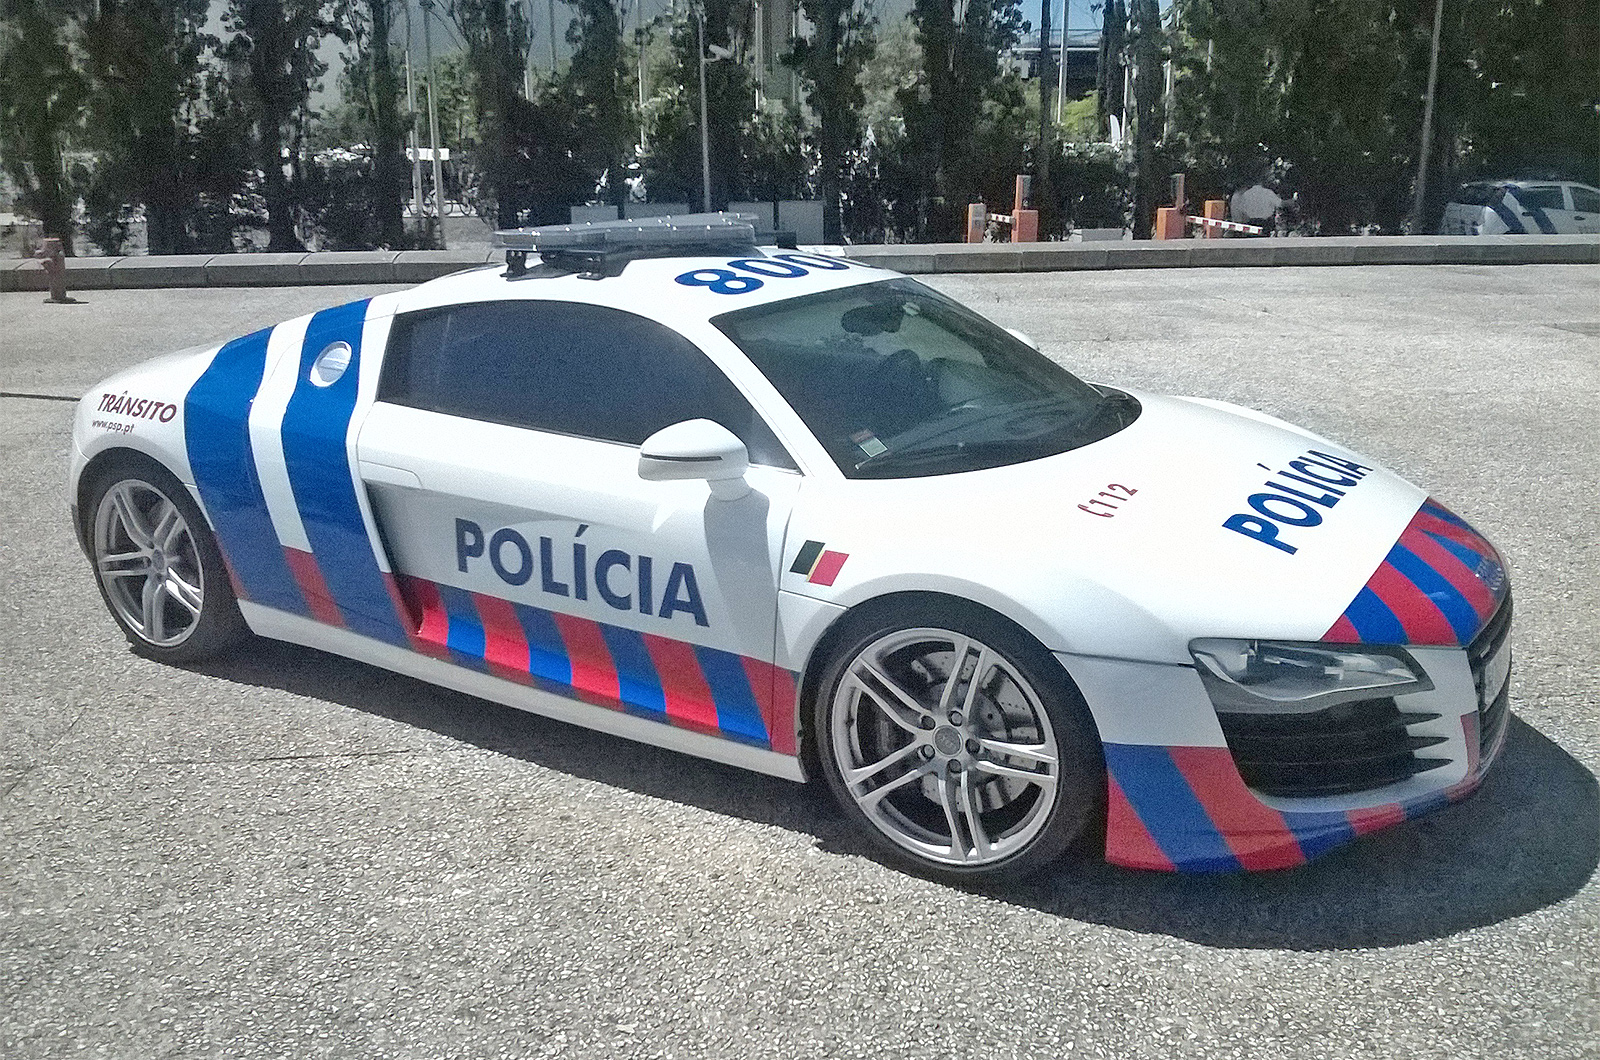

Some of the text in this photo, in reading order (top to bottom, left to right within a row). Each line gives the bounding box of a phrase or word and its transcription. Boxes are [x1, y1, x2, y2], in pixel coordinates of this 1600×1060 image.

[91, 420, 135, 435] www.psp.pt
[97, 390, 178, 423] TRÂNSITO
[1221, 449, 1375, 556] POLÍCIA
[454, 517, 711, 628] POLÍCIA
